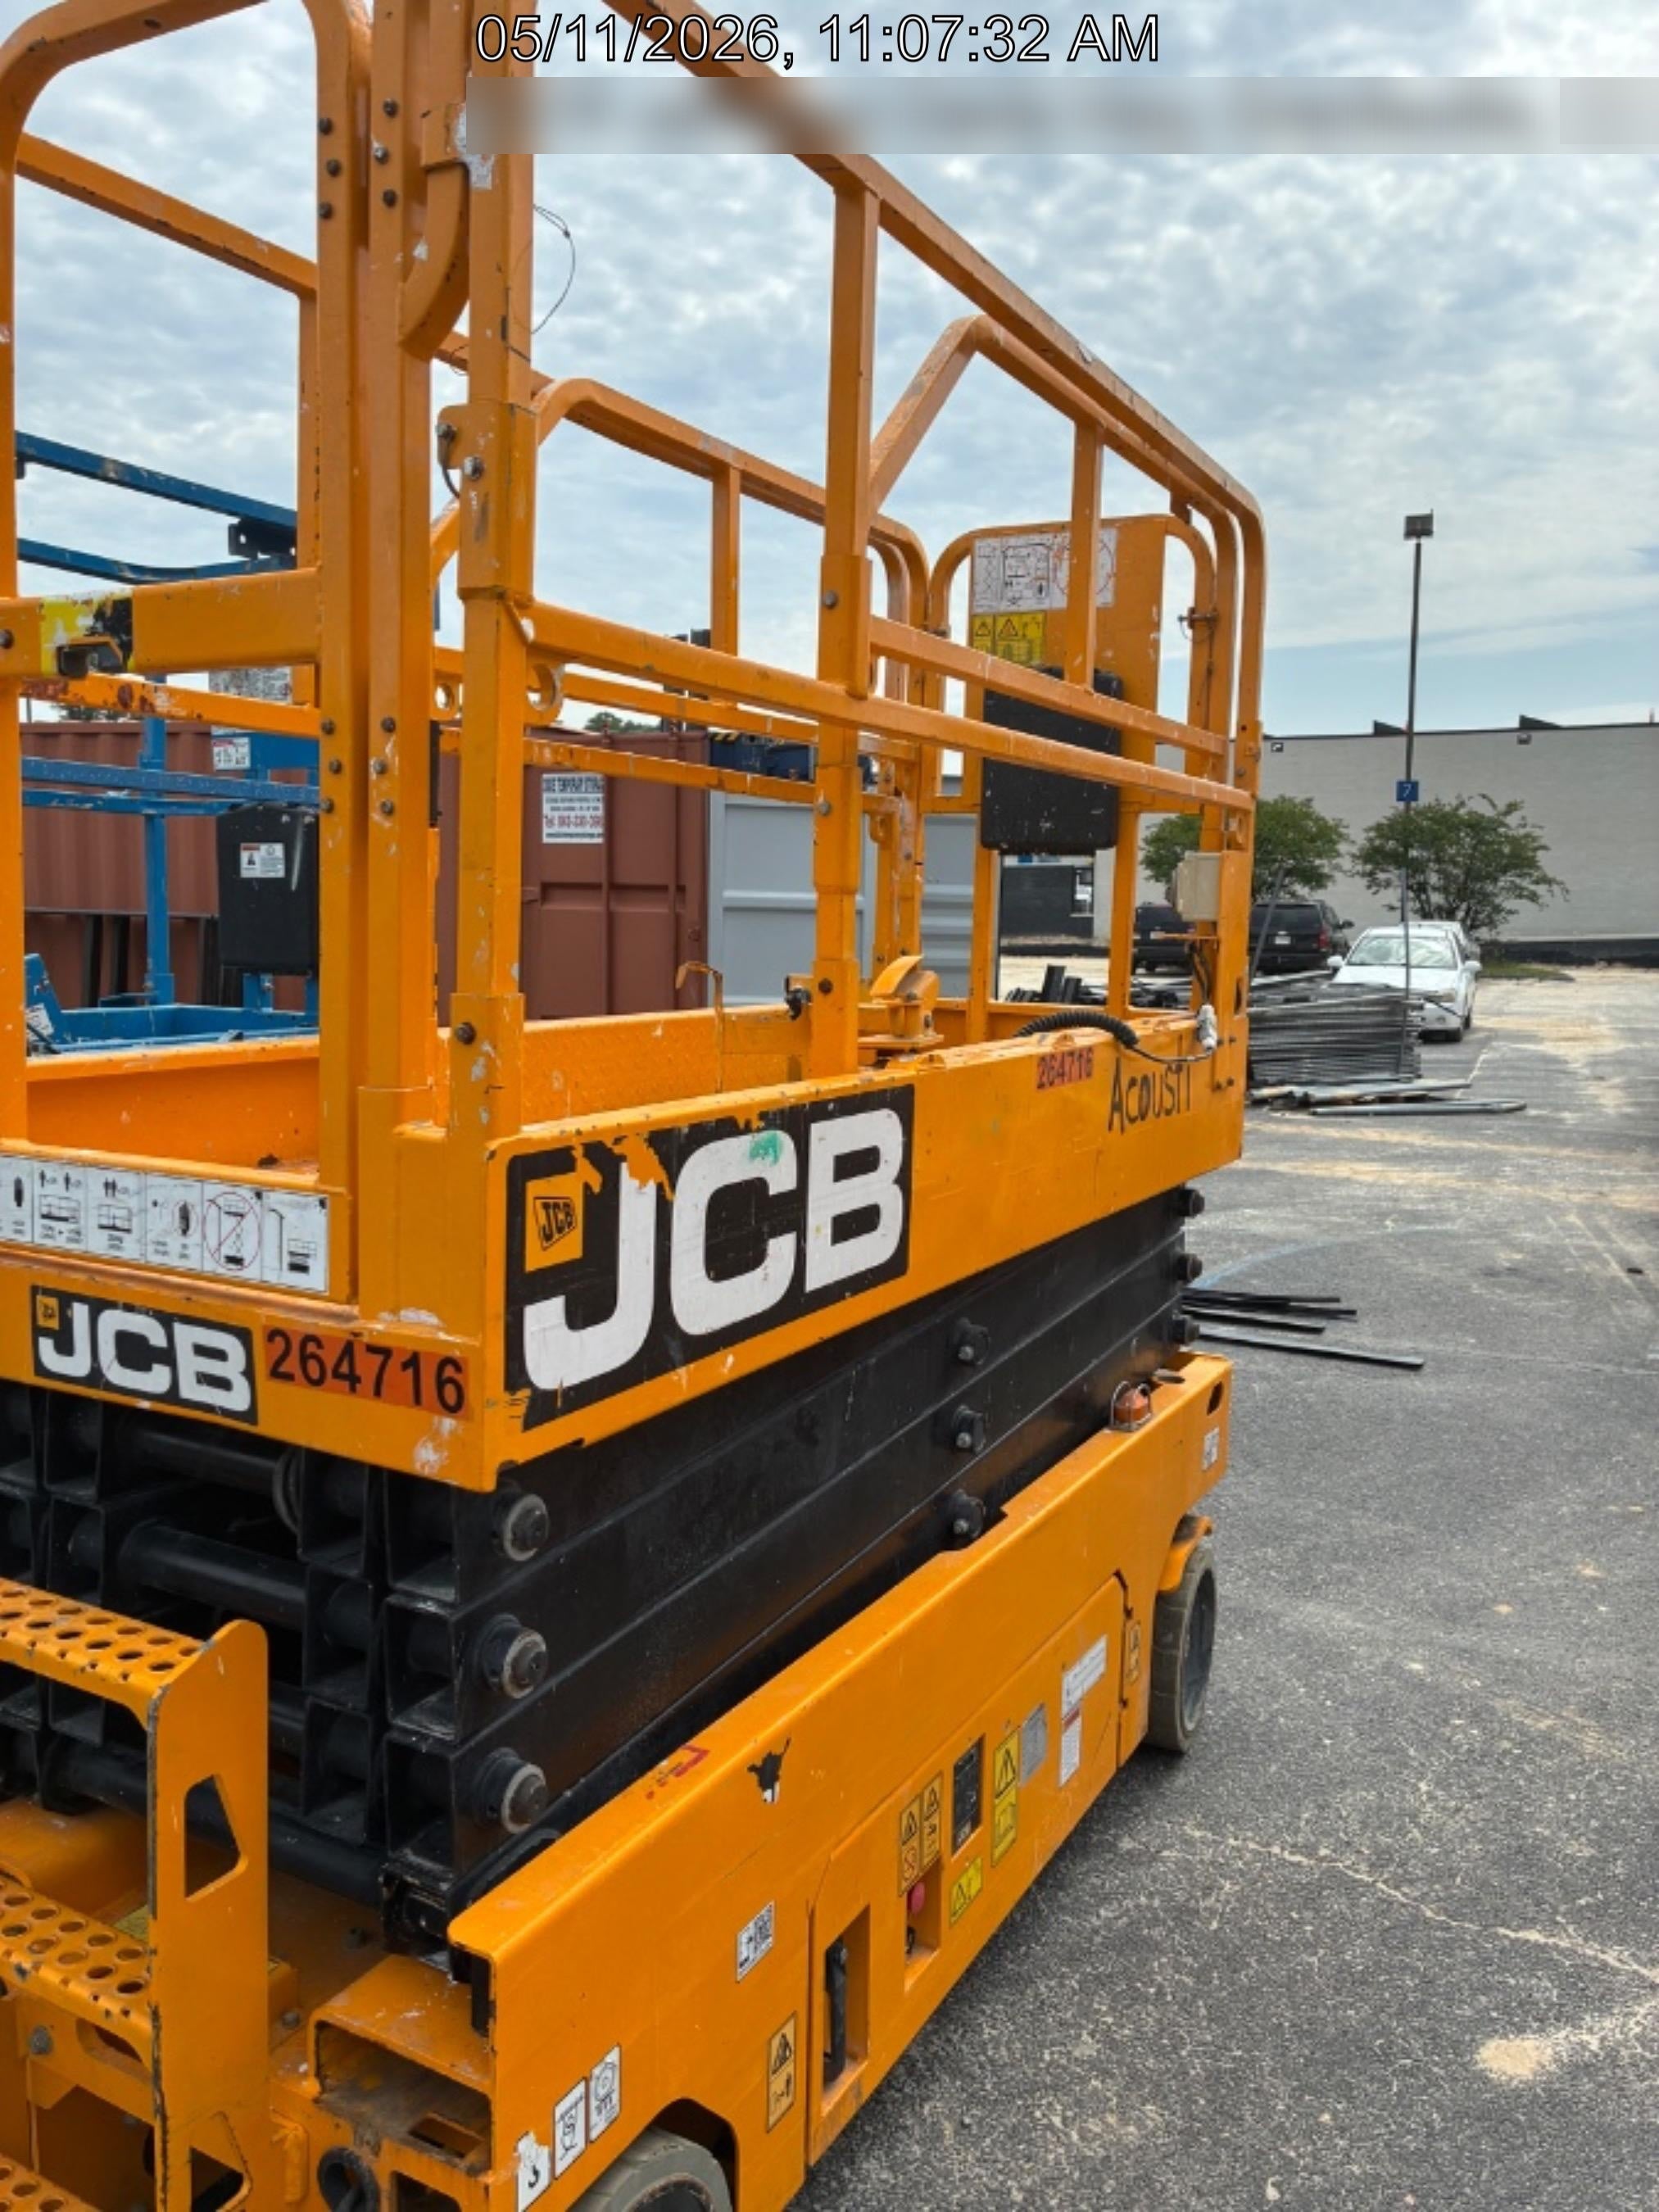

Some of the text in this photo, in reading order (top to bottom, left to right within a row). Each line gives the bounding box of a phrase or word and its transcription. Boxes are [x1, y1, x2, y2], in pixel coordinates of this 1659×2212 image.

[1402, 783, 1412, 798] 7
[524, 1108, 903, 1390] JCB
[542, 1201, 573, 1244] JCB
[38, 1302, 252, 1412] JCB
[266, 1327, 465, 1414] 264716
